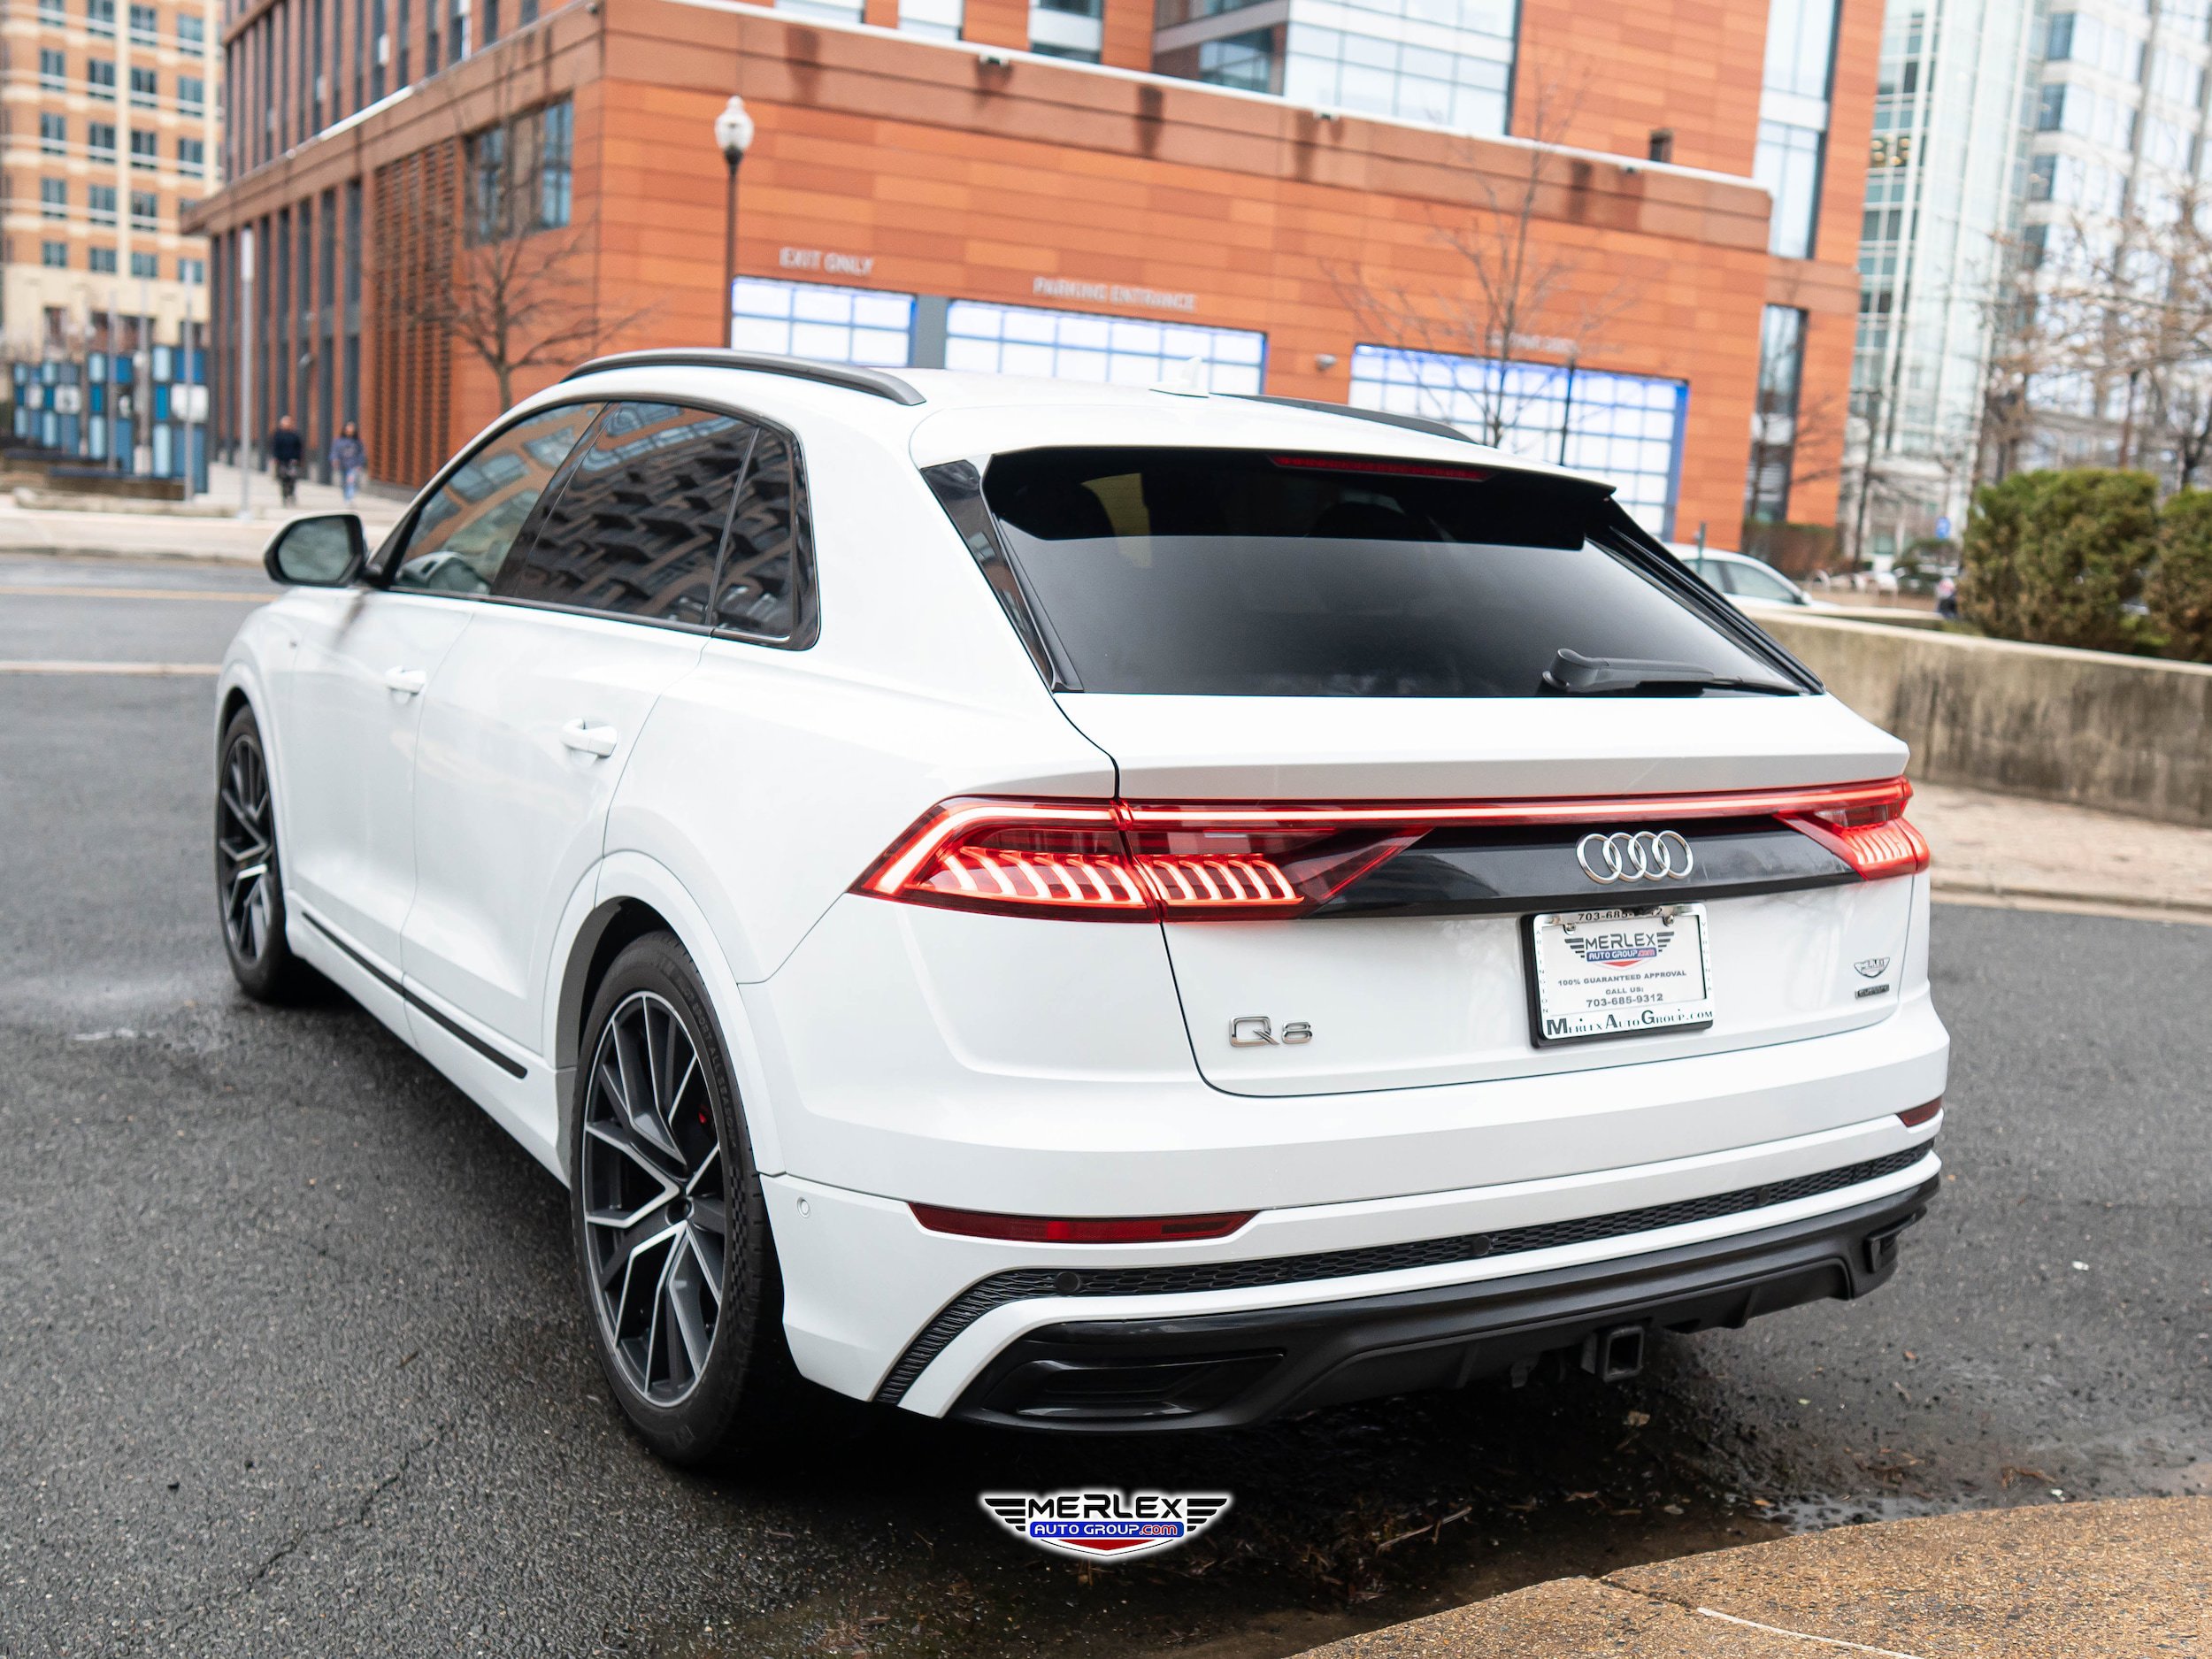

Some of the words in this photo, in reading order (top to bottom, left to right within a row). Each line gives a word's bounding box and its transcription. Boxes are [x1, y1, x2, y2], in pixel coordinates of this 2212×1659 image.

[780, 247, 820, 270] EXIT
[825, 252, 874, 276] ONLY
[1033, 276, 1107, 302] PARKING
[1110, 283, 1197, 312] ENTRANCE
[1586, 933, 1655, 949] MERLEX
[1589, 951, 1610, 960] AUTO
[1557, 978, 1581, 987] 100%
[1584, 974, 1641, 984] GUARANTEED
[1644, 970, 1686, 979] APPROVAL
[1586, 993, 1663, 1008] 703-685-9312
[1228, 1014, 1314, 1048] Q8
[709, 1047, 722, 1072] ALL
